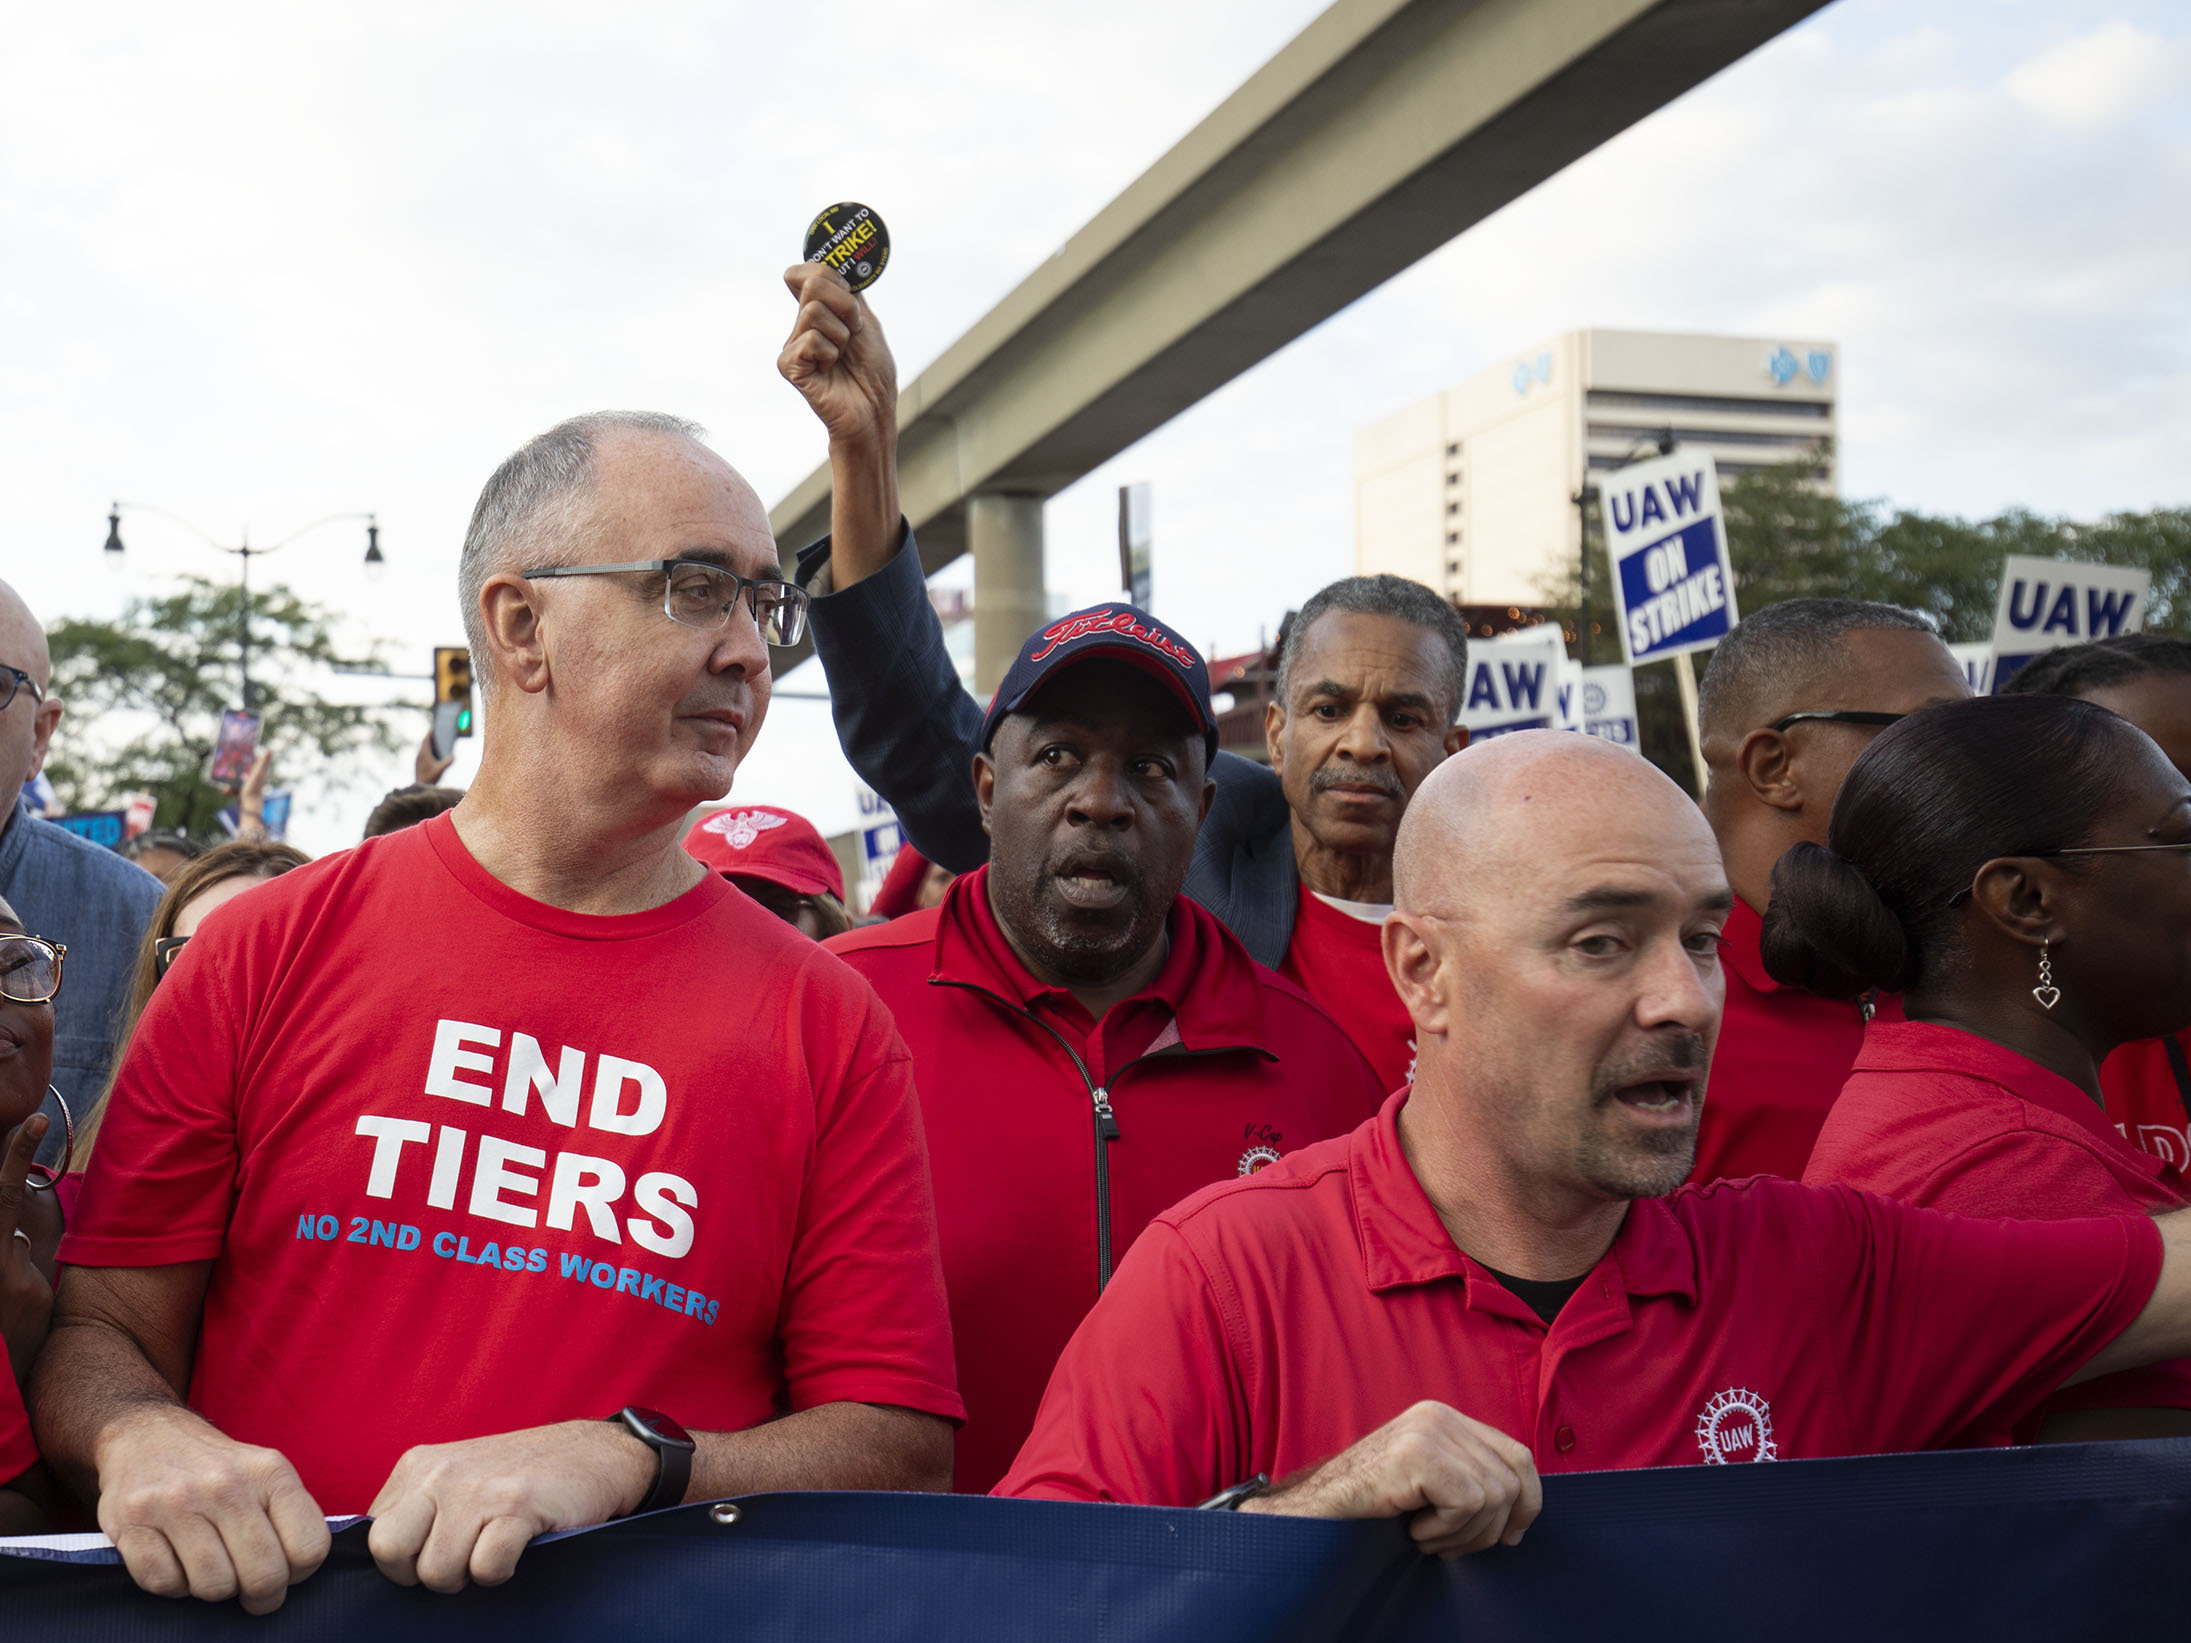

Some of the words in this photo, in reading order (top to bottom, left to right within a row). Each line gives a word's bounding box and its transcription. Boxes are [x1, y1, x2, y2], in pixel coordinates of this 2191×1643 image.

[820, 219, 877, 267] TRIKE!
[823, 220, 836, 234] I
[832, 219, 856, 244] WANT
[855, 208, 869, 221] TO
[838, 261, 851, 275] UT
[1611, 471, 1704, 533] UAW
[1644, 533, 1689, 594] ON
[1627, 562, 1725, 654] STRIKE
[2009, 579, 2136, 638] UAW
[1031, 608, 1195, 669] Titleist
[1468, 661, 1546, 711] AW
[424, 1018, 667, 1136] END
[355, 1114, 698, 1259] TIERS
[296, 1213, 340, 1241] NO
[346, 1216, 421, 1251] 2ND
[433, 1231, 548, 1273] CLASS
[560, 1252, 720, 1326] WORKERS
[1719, 1423, 1754, 1453] UAW
